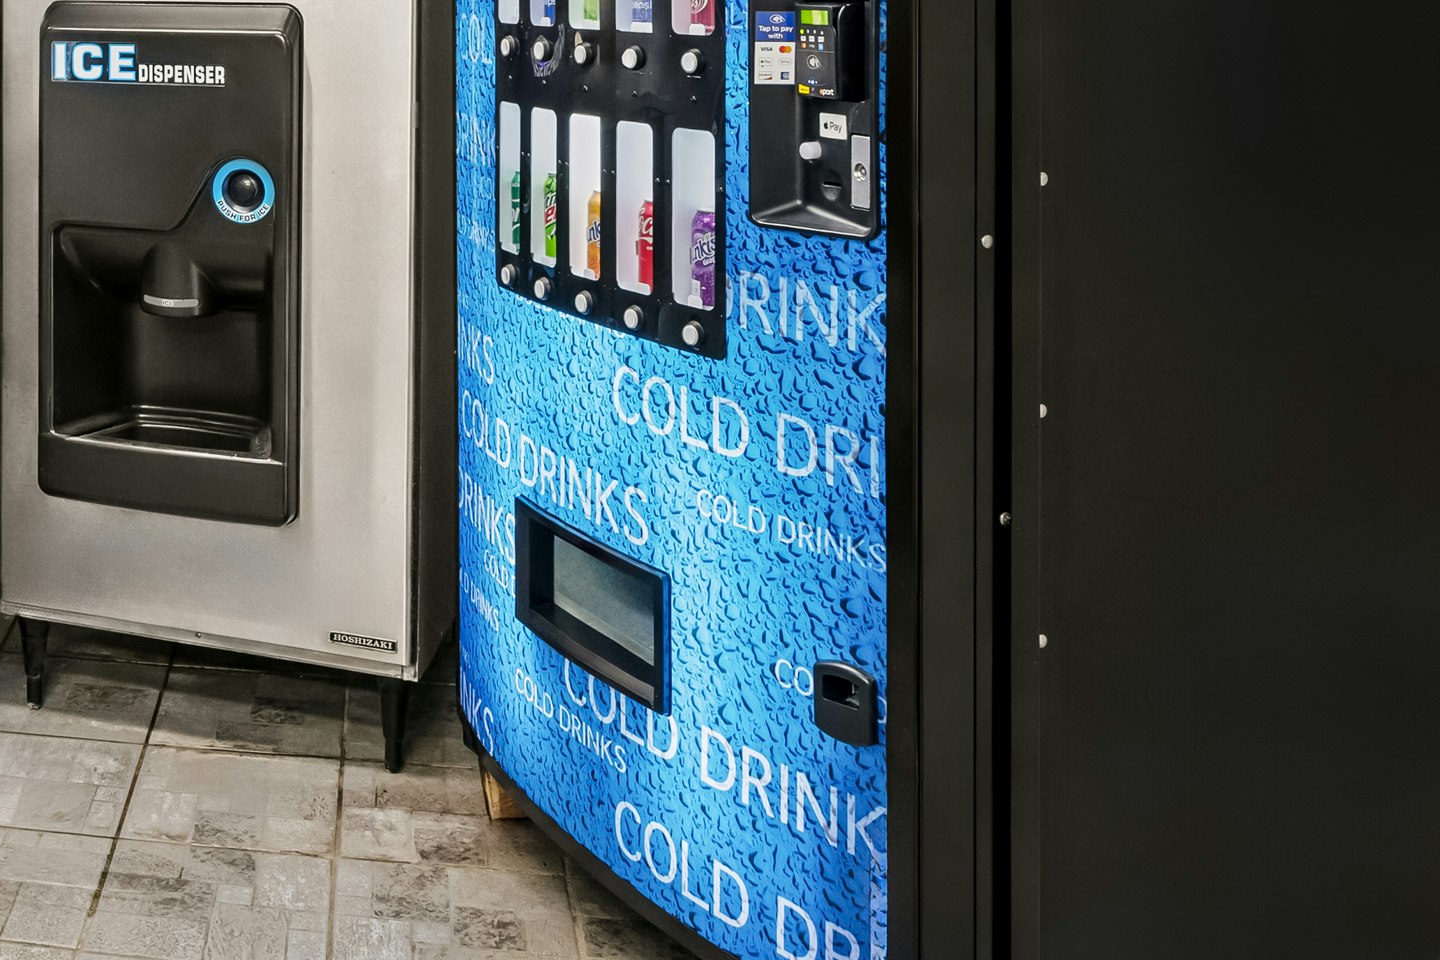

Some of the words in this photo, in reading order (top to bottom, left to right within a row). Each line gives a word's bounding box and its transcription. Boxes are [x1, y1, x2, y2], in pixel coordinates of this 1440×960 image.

[758, 25, 771, 33] Tap
[53, 43, 136, 81] ICE
[138, 64, 225, 84] DISPENSER
[830, 121, 842, 133] Pay
[217, 200, 236, 222] PUSH
[239, 214, 257, 223] FOR
[258, 205, 269, 217] ICE
[613, 365, 749, 458] COLD
[463, 389, 510, 468] COLD
[520, 433, 649, 546] DRINKS
[696, 489, 766, 534] COLD
[777, 516, 887, 574] DRINKS
[484, 550, 508, 589] COLD
[470, 581, 499, 632] DRINKS
[333, 633, 392, 649] HOSHIZAKI
[774, 658, 814, 697] CO
[515, 668, 554, 718] COLD
[560, 705, 627, 774] DRINKS
[564, 658, 678, 760] COLD
[701, 725, 887, 865] DRINK
[615, 801, 749, 928] COLD
